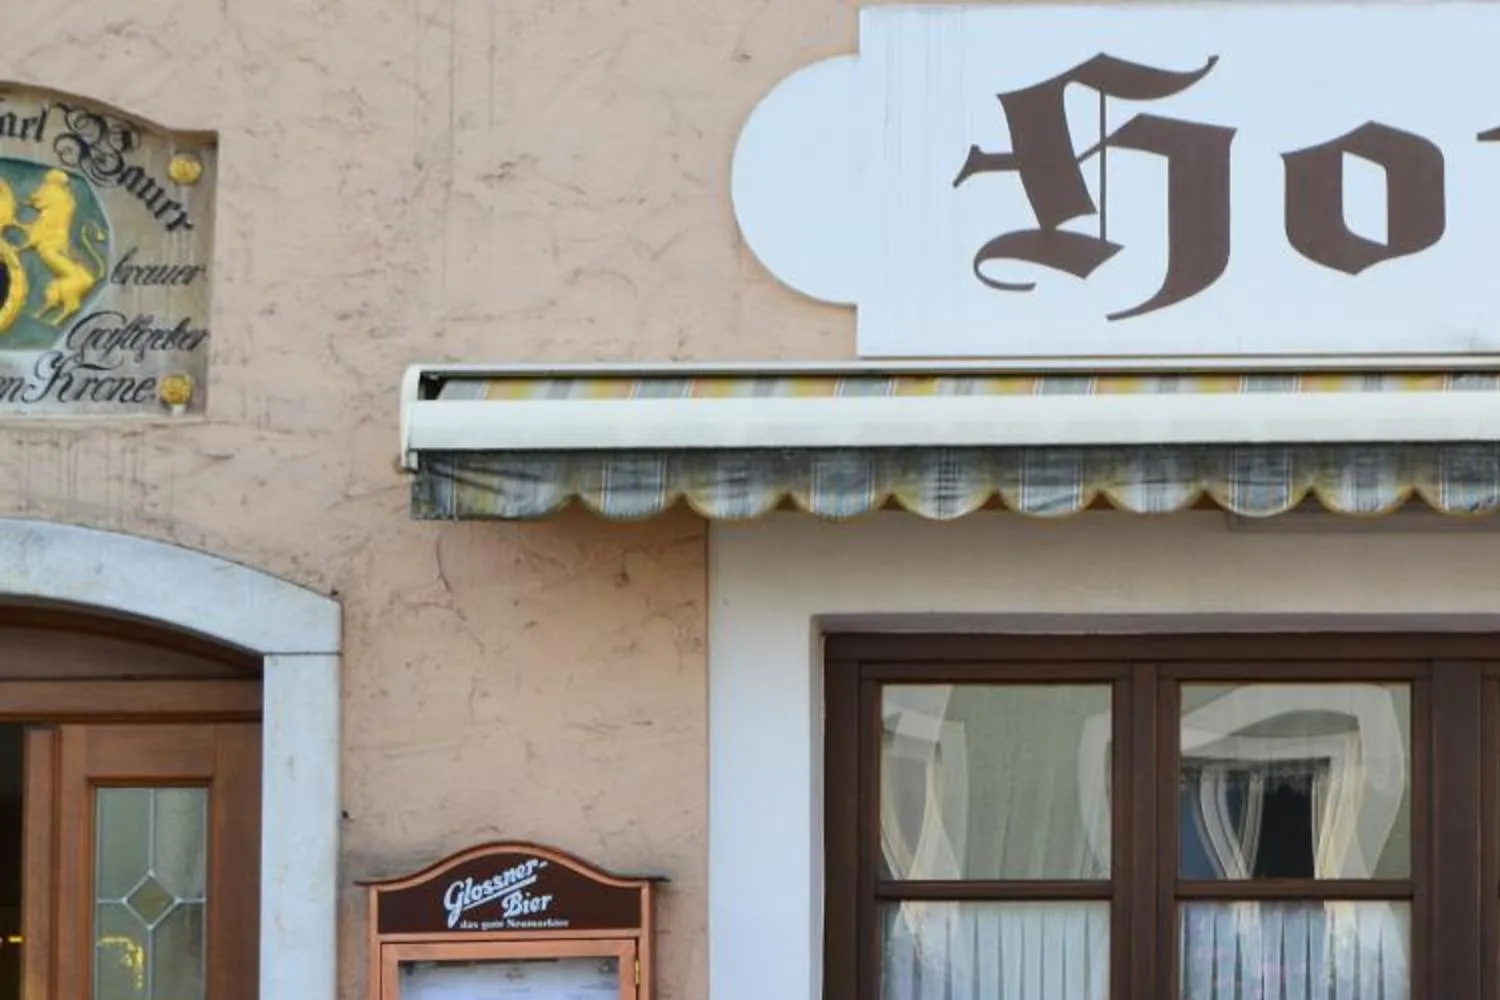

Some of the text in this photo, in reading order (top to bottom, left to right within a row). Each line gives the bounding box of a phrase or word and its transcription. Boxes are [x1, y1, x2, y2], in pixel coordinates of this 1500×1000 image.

[0, 108, 50, 142] arl
[22, 351, 156, 403] Krone
[501, 889, 553, 918] Bier
